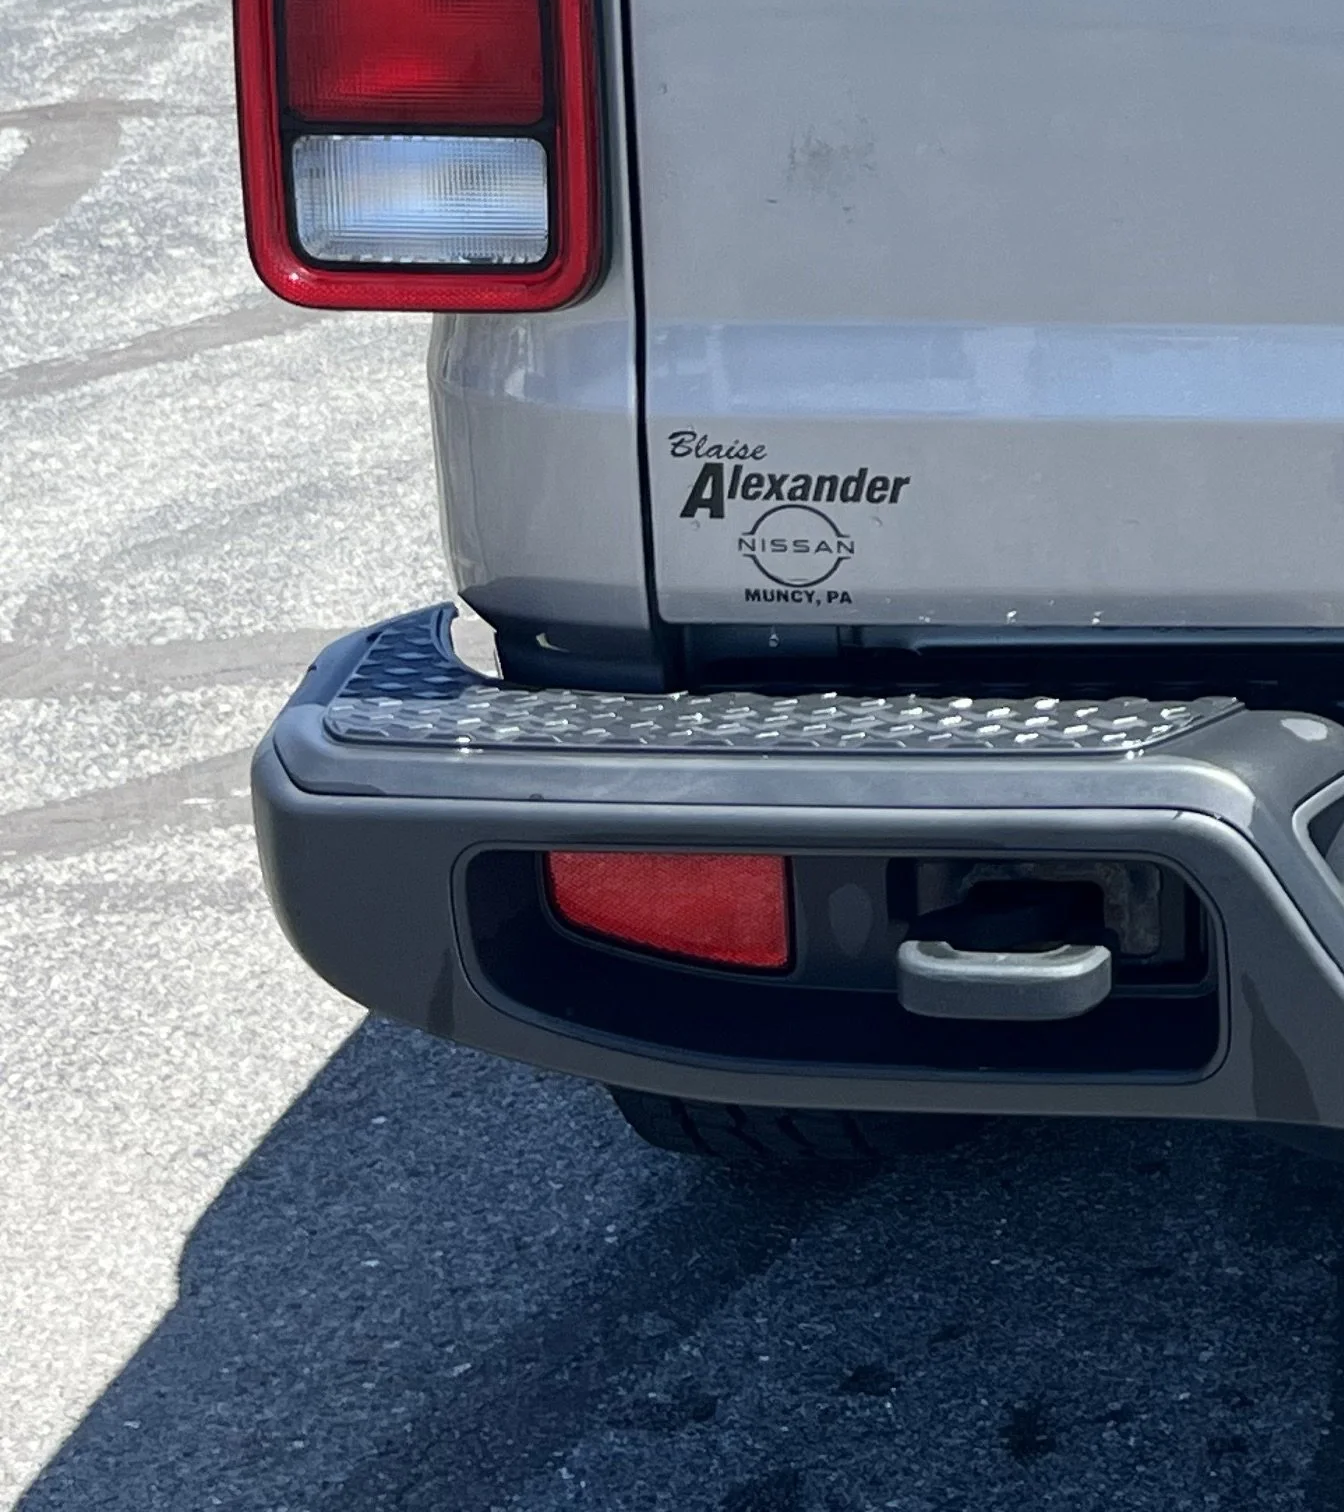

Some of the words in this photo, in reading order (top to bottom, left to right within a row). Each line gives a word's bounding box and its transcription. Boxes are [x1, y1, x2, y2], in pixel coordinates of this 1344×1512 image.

[668, 430, 768, 461] Blaise
[678, 462, 912, 520] Alexander
[738, 538, 855, 554] NISSAN
[745, 588, 822, 607] MUNCY,
[826, 590, 853, 605] PA
